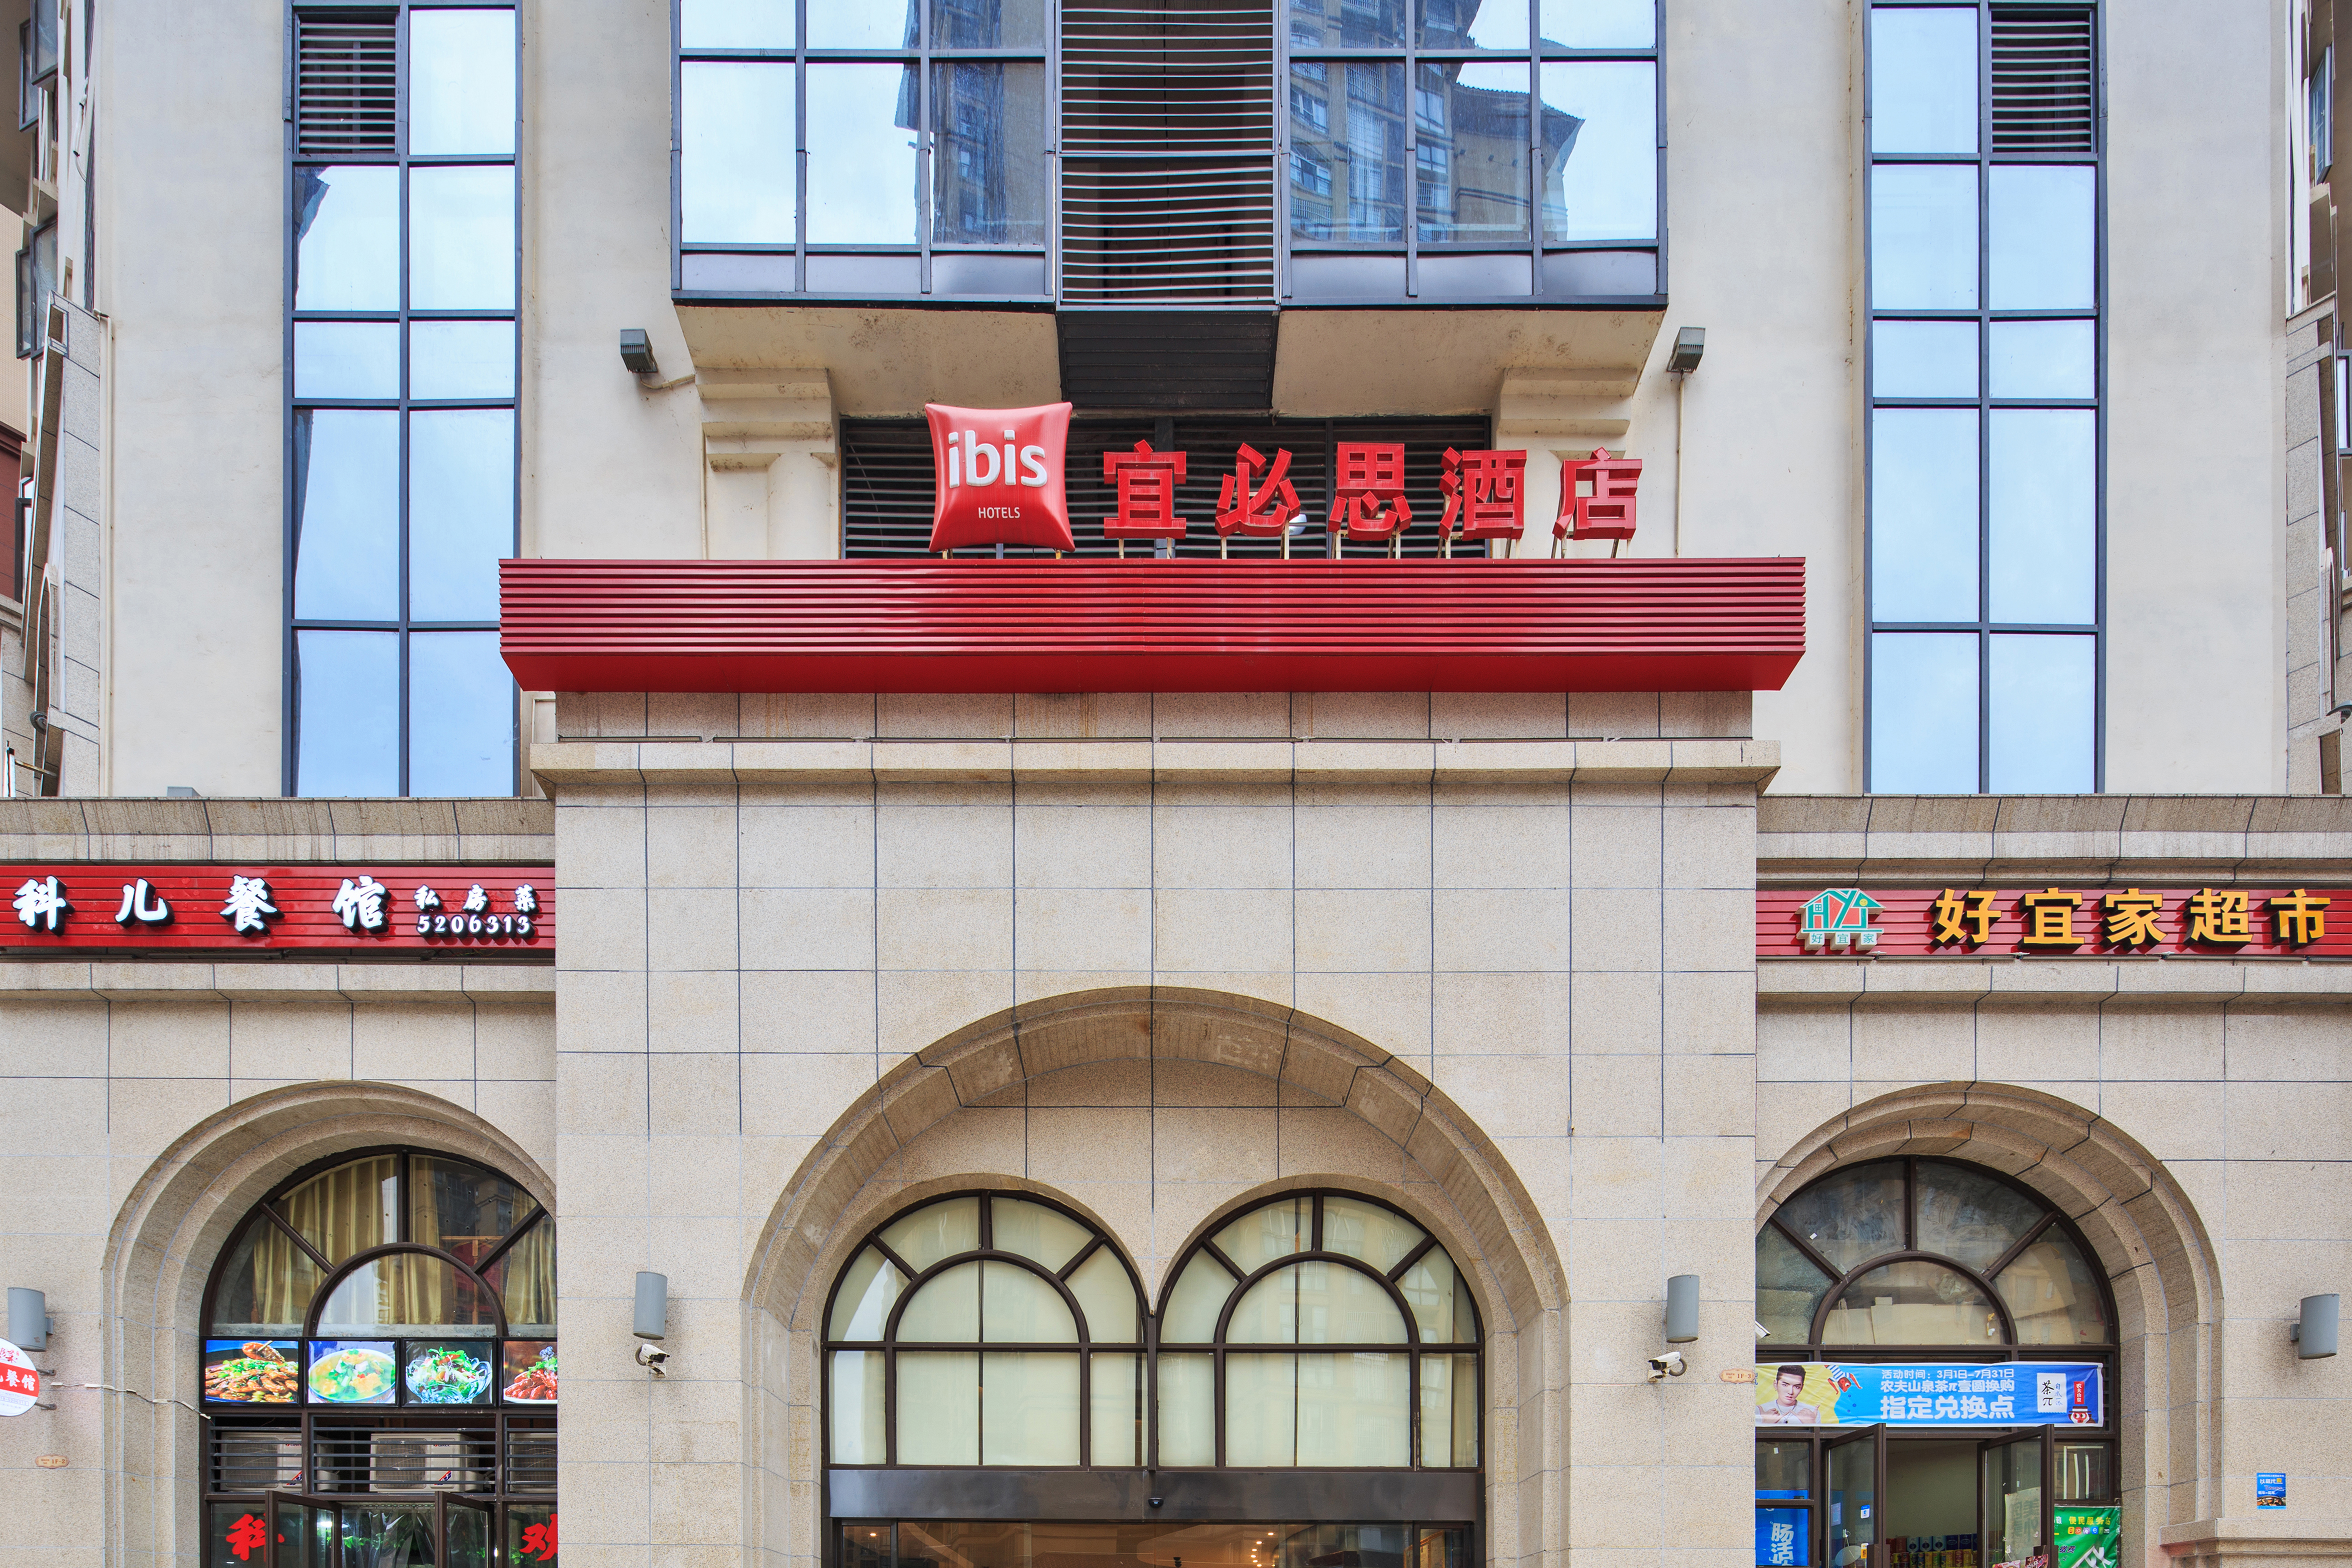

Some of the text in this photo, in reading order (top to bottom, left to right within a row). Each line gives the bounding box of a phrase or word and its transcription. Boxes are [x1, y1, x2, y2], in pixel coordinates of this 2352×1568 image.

[948, 429, 1048, 488] ibis
[1103, 438, 1642, 542] 宜必思酒店
[978, 507, 1020, 518] HOTELS
[12, 874, 390, 933] 科儿餐馆
[414, 883, 537, 913] 私房菜
[416, 914, 531, 934] 5206313
[1933, 887, 2331, 946] 好宜家超市
[1811, 933, 1875, 944] 好宜家
[1880, 1380, 2015, 1393] 农夫山泉茶π壹圆换购
[1880, 1395, 2015, 1420] 指定兑换点
[2069, 1516, 2111, 1525] 便民服务站
